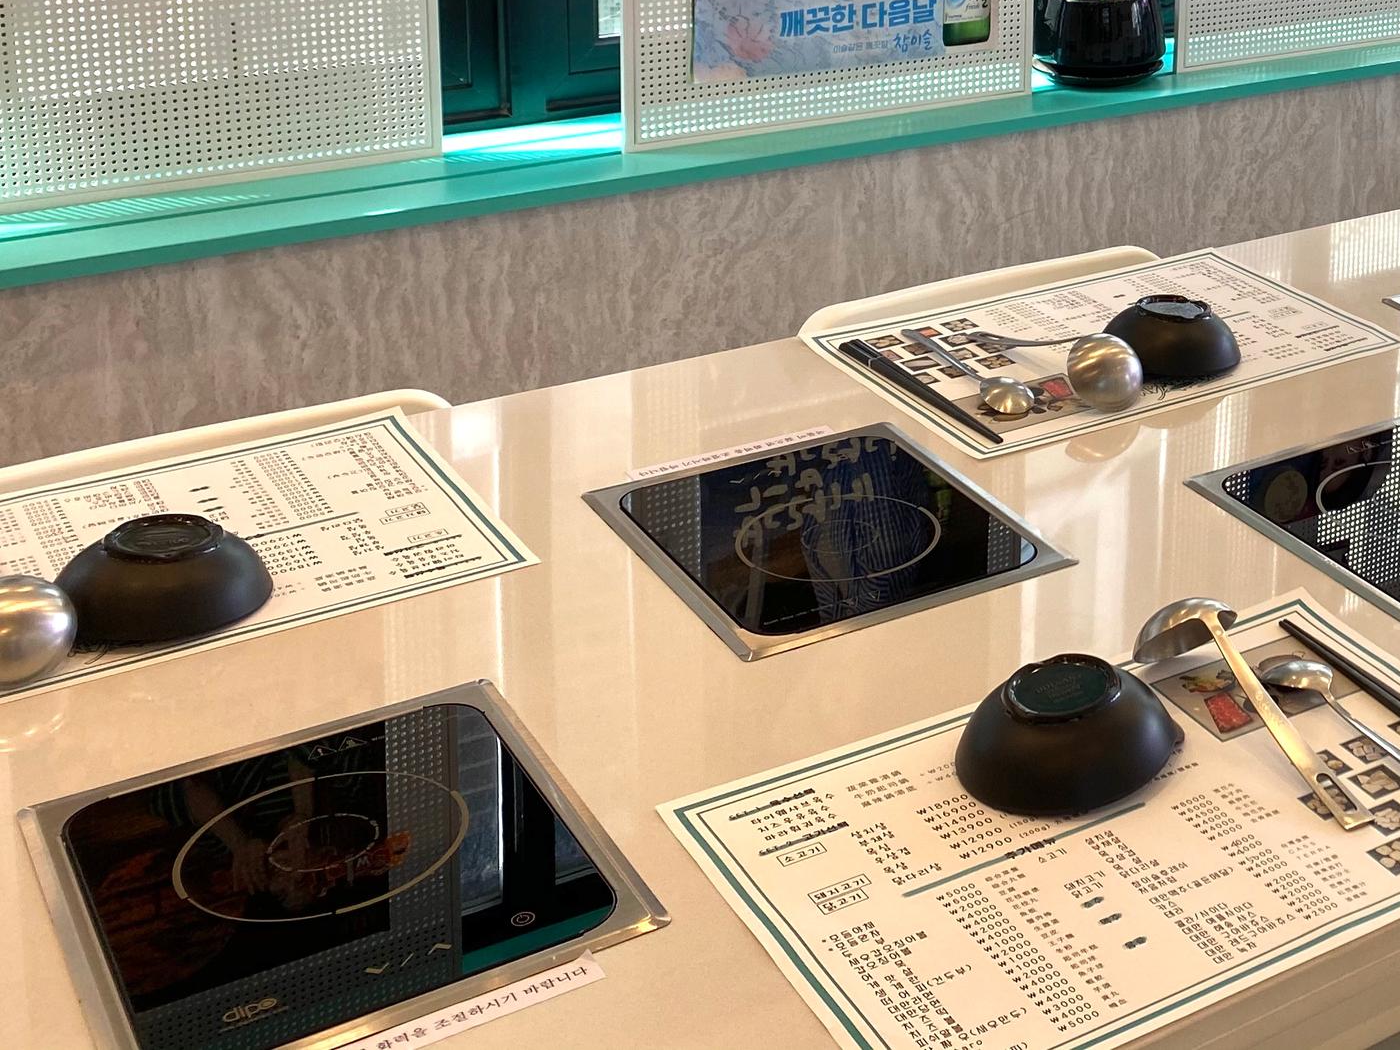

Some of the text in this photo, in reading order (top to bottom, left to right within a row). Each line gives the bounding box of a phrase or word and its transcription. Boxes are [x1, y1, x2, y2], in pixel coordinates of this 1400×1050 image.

[779, 4, 856, 38] 깨끗한
[893, 29, 933, 51] 참이슬
[851, 823, 887, 838] 살치살
[859, 831, 894, 846] 부채살
[785, 847, 820, 862] 소고기
[866, 843, 891, 855] 목심
[875, 847, 911, 863] 우삼겹
[1038, 847, 1068, 864] 소고기
[891, 862, 943, 885] 닭다리살
[1064, 870, 1106, 892] 돼지고기
[813, 878, 866, 901] 돼지고기
[1071, 881, 1104, 899] 닭고기
[822, 893, 863, 912] 닭고기
[830, 921, 875, 942] 모듬야채
[222, 998, 277, 1023] dipo
[376, 965, 588, 1050] 화력을 조절하시기 바랍니다
[888, 991, 934, 1014] 대만라면
[895, 999, 941, 1022] 대만당면
